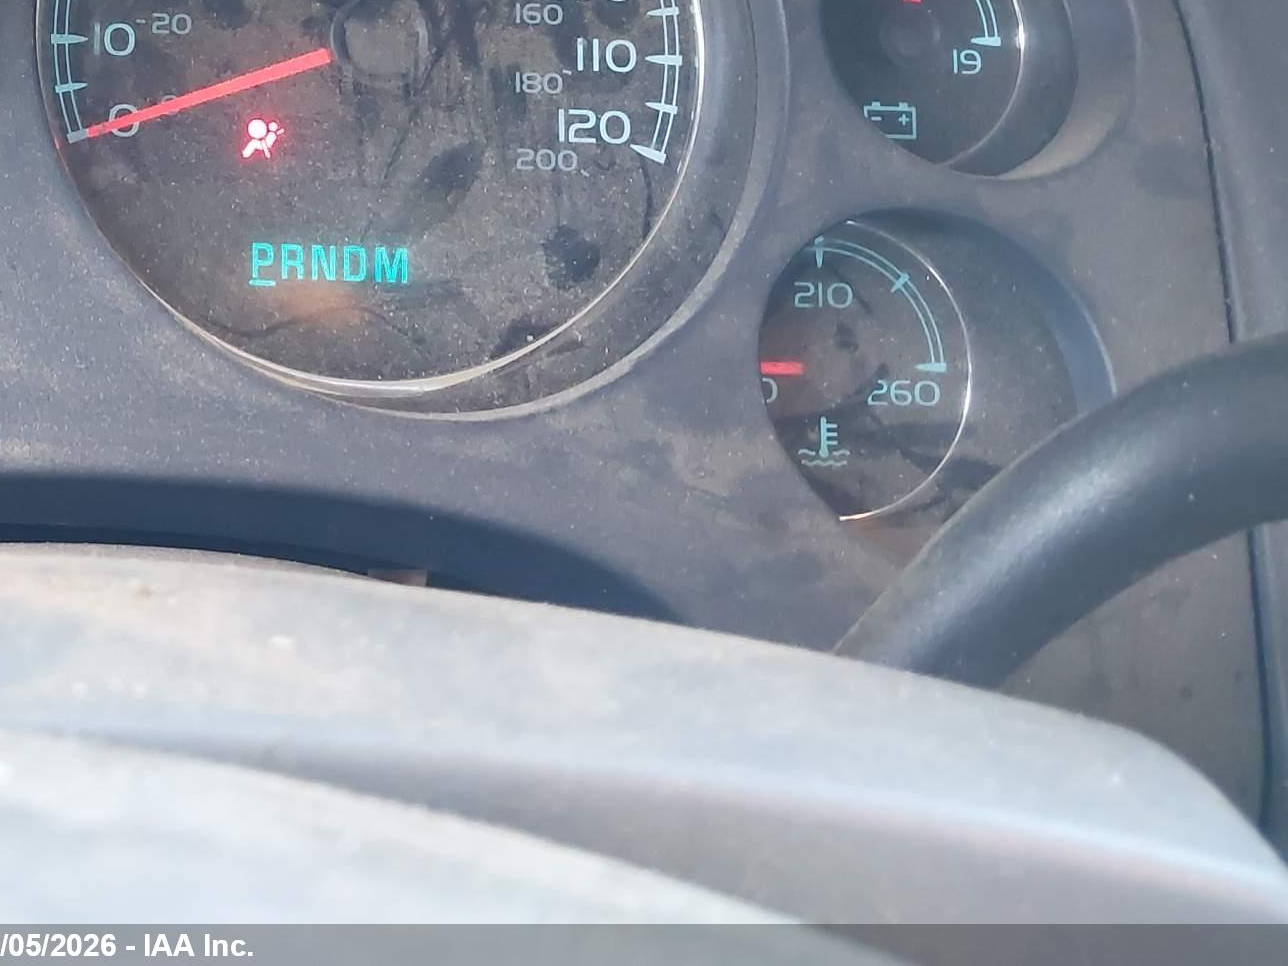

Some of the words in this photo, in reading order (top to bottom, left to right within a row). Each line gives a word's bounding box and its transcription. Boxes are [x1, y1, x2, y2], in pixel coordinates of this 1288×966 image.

[151, 13, 192, 35] 20
[515, 3, 563, 25] 160
[94, 22, 136, 56] 10
[576, 37, 637, 73] 110
[952, 49, 983, 75] 19
[515, 71, 563, 94] 180
[558, 108, 631, 145] 120
[516, 148, 578, 172] 200
[249, 242, 410, 286] PRNDM
[794, 282, 853, 308] 210
[867, 380, 941, 407] 260
